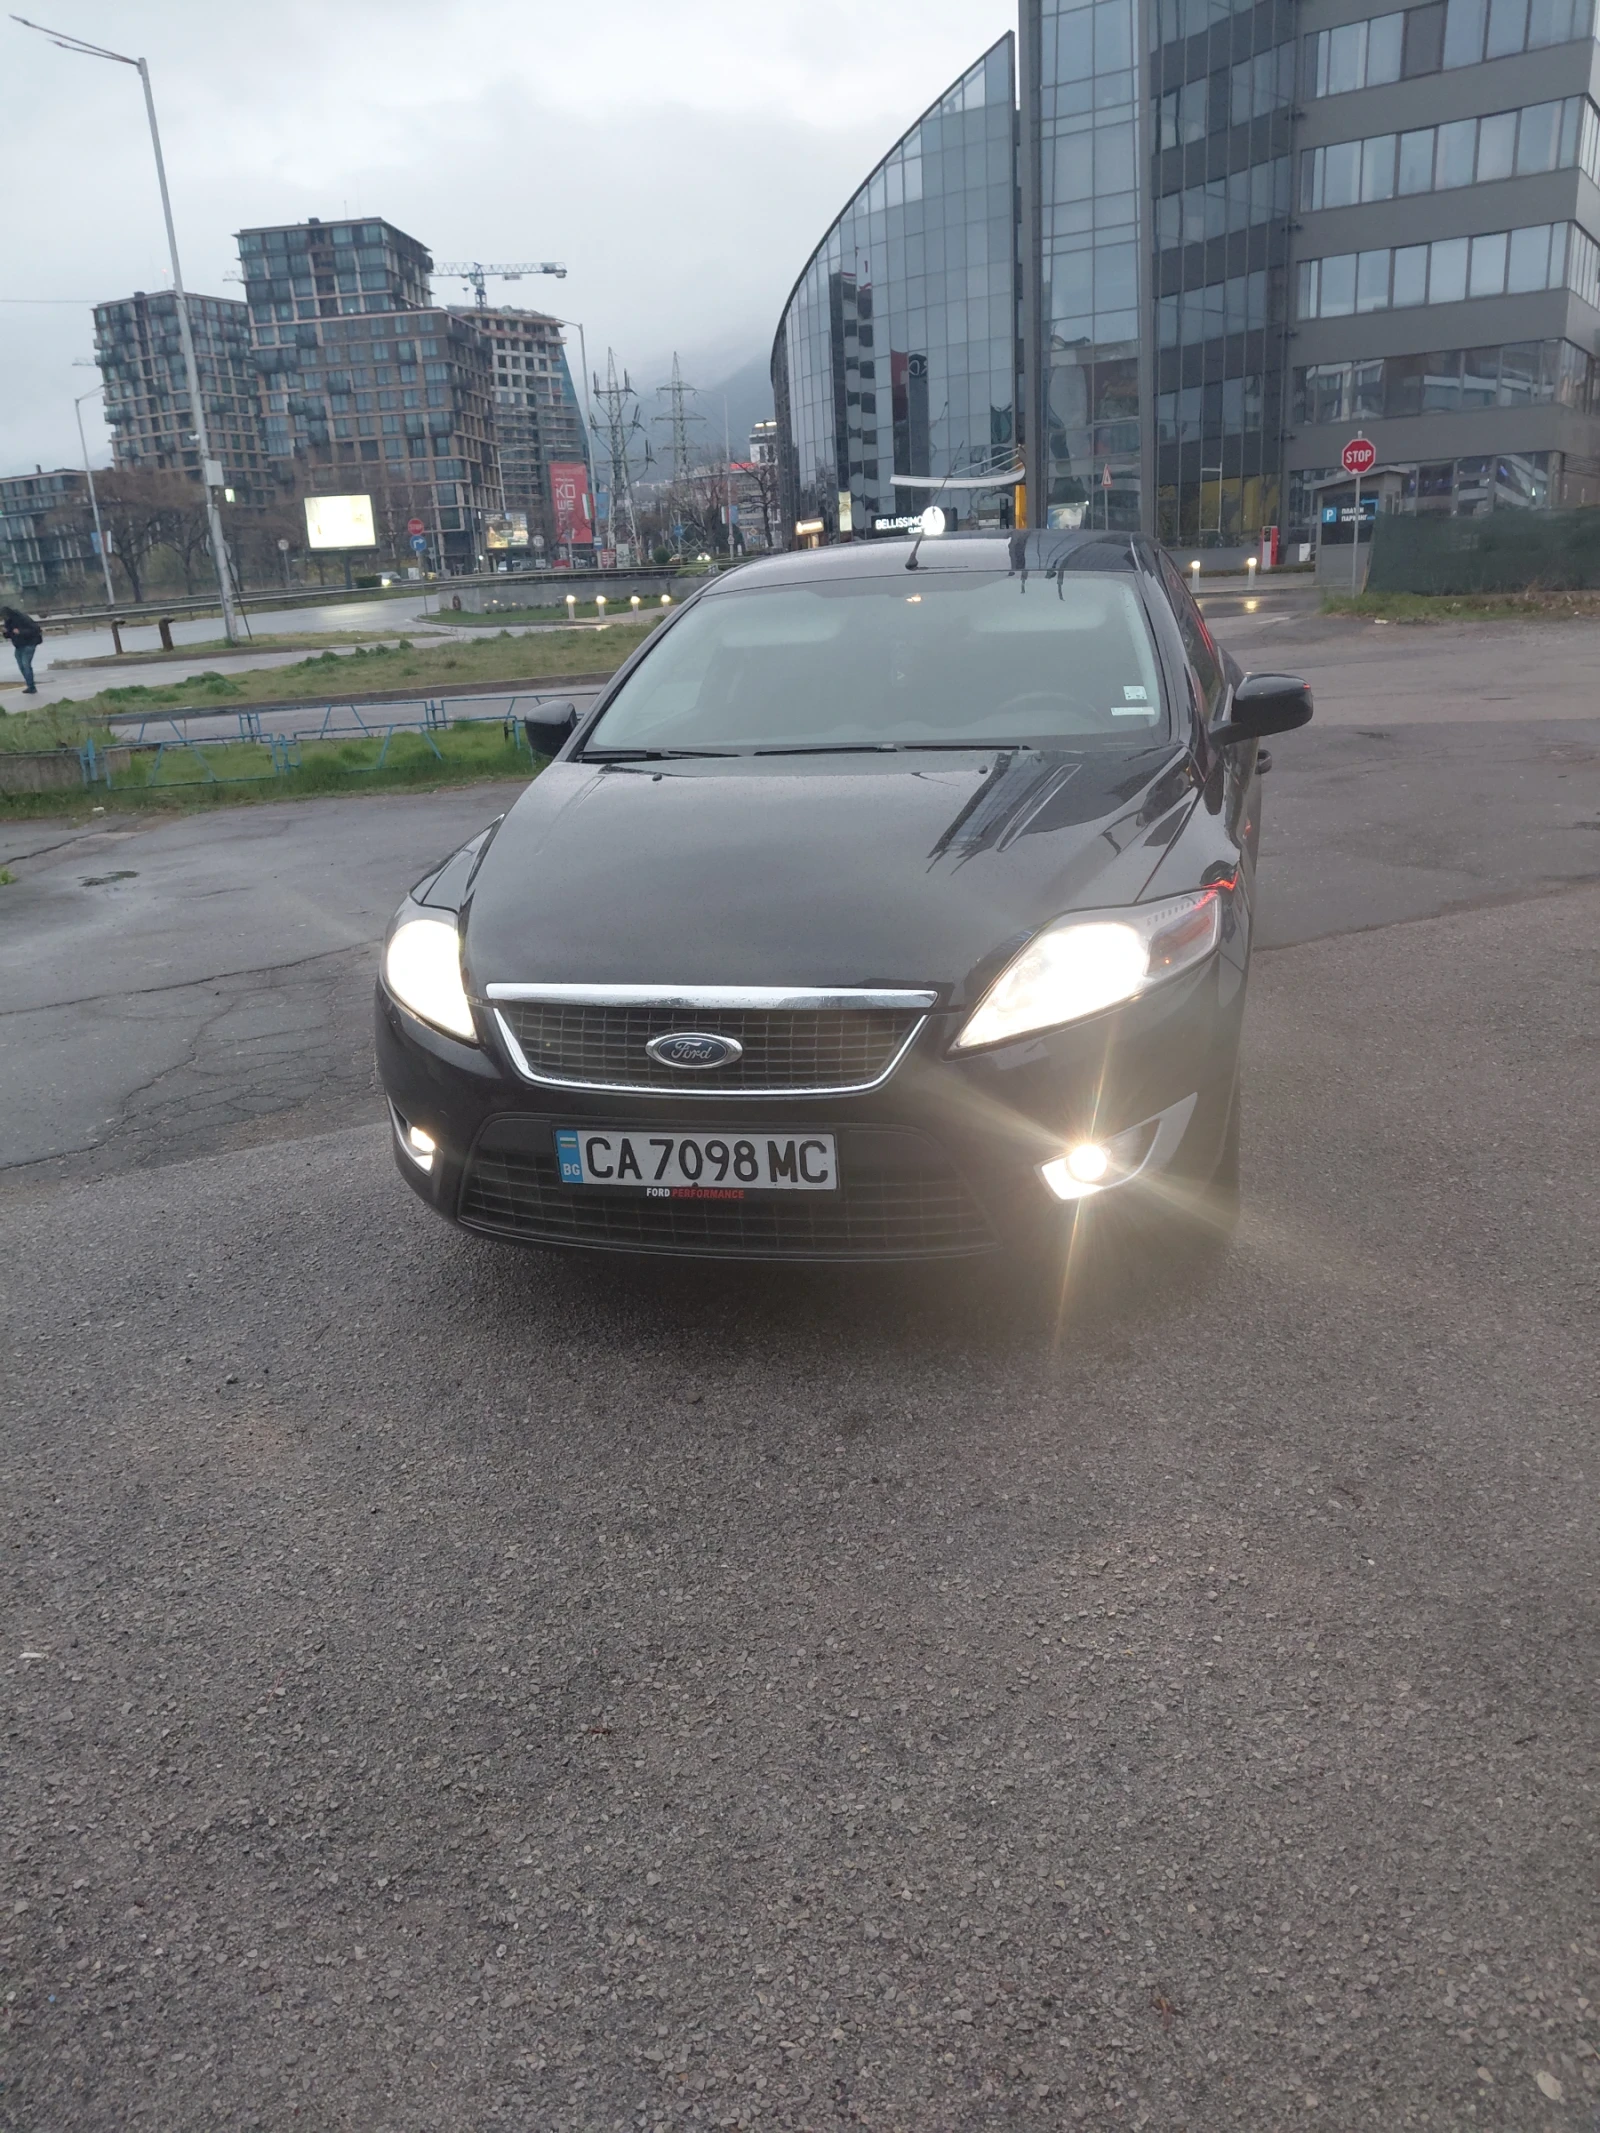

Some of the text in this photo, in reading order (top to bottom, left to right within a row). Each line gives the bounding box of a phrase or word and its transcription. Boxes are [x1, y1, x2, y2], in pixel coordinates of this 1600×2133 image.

[1345, 449, 1372, 464] STOP
[1326, 509, 1334, 521] P
[875, 515, 924, 530] BELLISSIMO
[671, 1041, 712, 1059] Ford
[563, 1163, 581, 1176] BG
[646, 1187, 745, 1199] FORD PERFORMANCE
